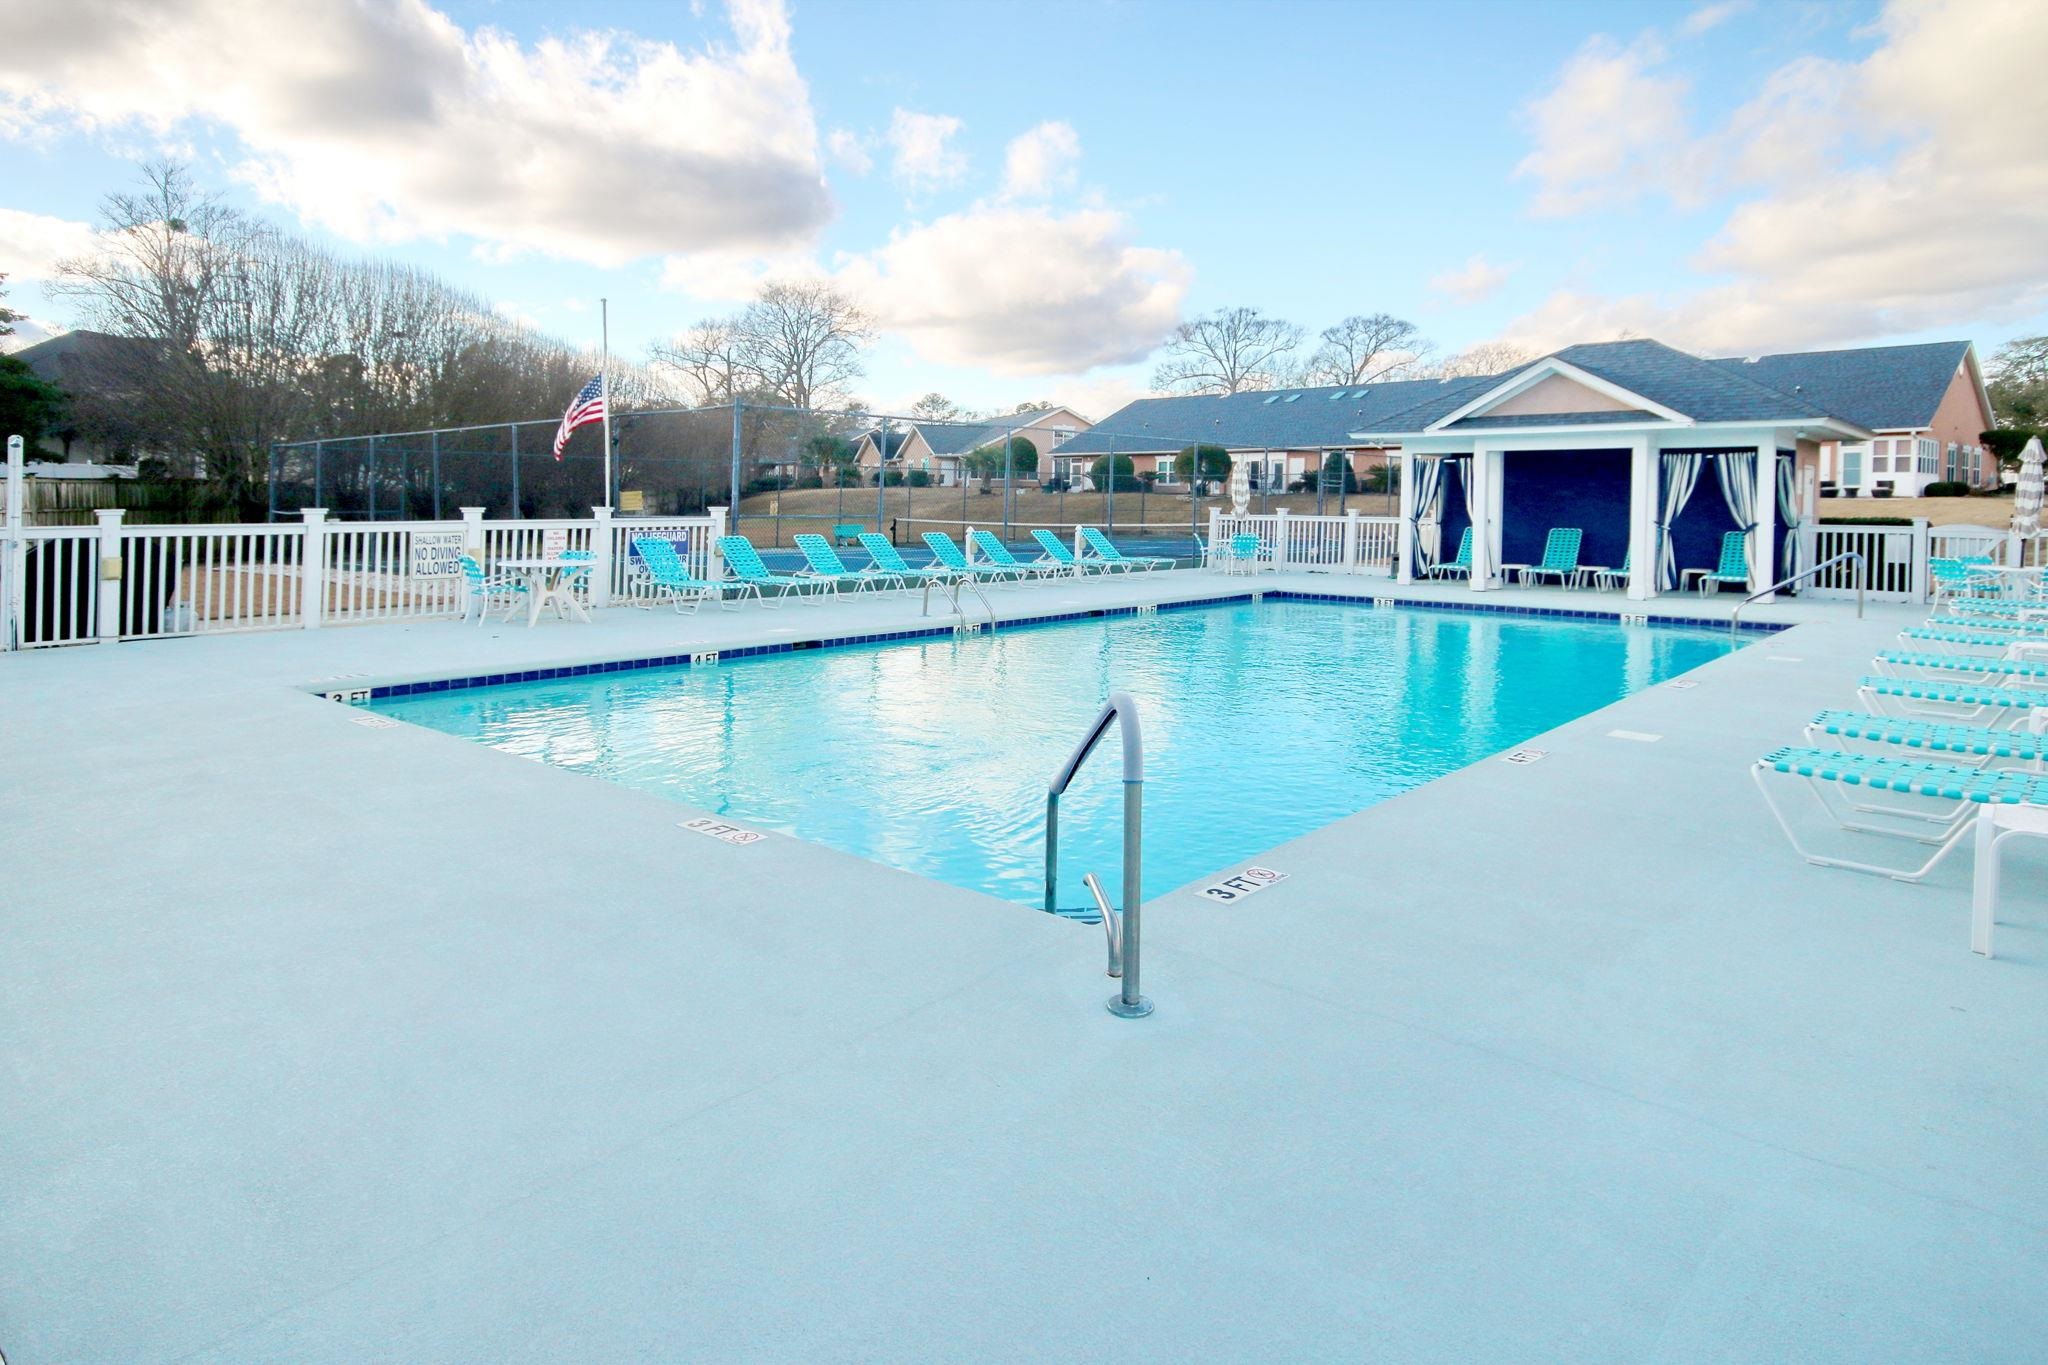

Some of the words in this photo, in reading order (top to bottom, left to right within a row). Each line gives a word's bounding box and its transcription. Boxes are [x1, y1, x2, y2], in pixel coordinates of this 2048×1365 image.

[415, 535, 441, 545] SHALLOW
[443, 535, 462, 544] WATER
[415, 547, 428, 560] NO
[430, 546, 461, 560] DIVING
[416, 561, 460, 575] ALLOWED
[706, 653, 717, 661] FT
[351, 691, 369, 702] FT
[703, 825, 740, 835] FT
[1206, 888, 1236, 899] 3
[1222, 876, 1262, 892] FT
